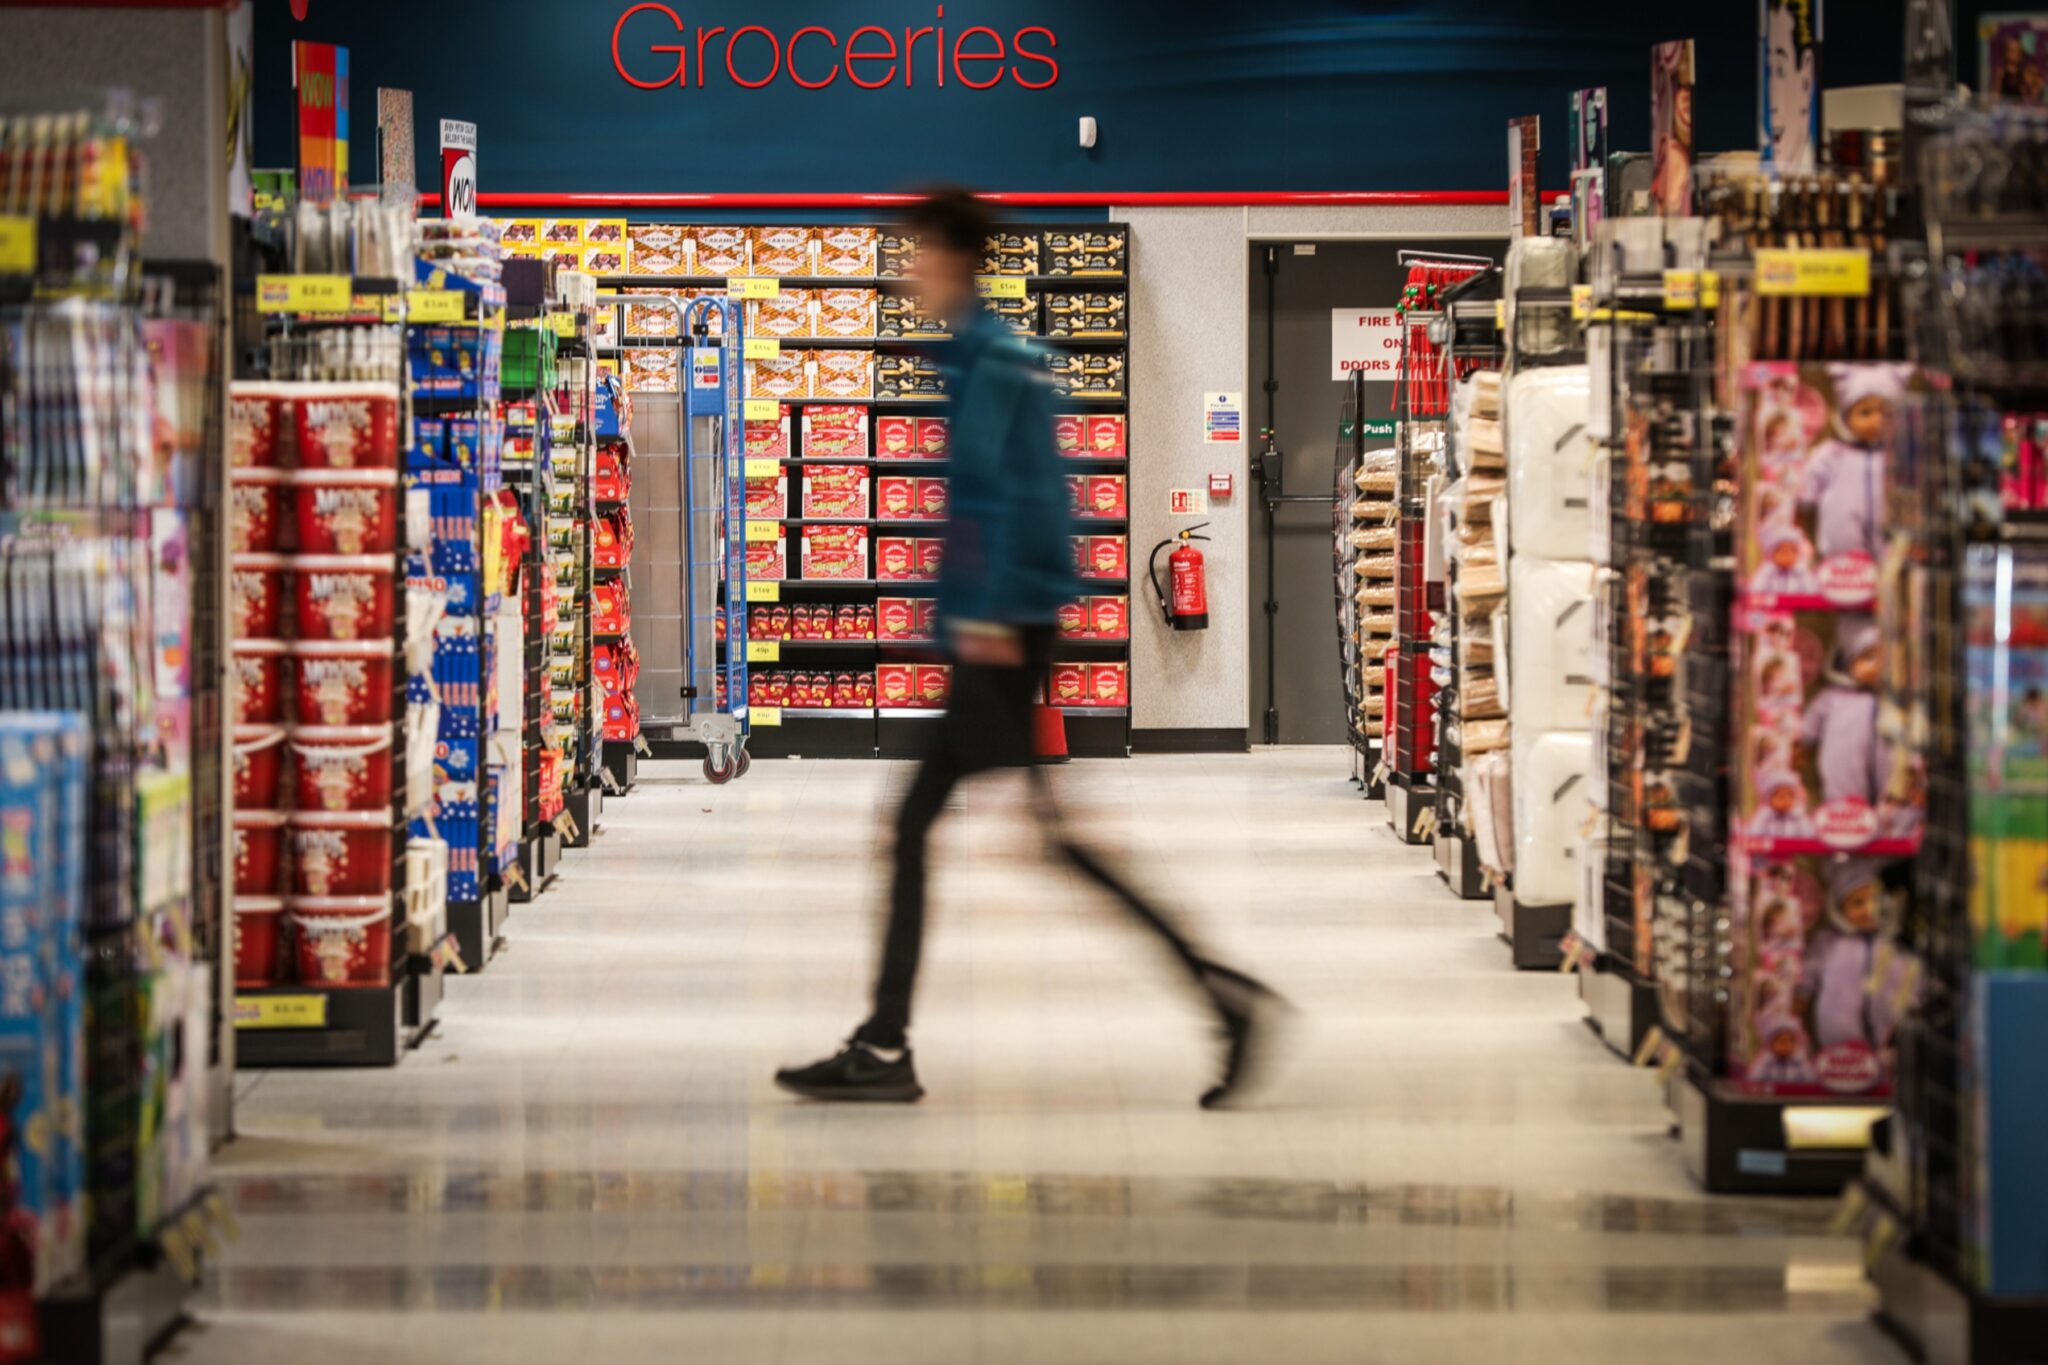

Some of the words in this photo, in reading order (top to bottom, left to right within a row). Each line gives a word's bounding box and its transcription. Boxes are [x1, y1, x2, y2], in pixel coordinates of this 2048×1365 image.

[611, 2, 1059, 89] Groceries
[1359, 316, 1391, 327] FIRE
[1341, 361, 1390, 371] DOORS
[1363, 424, 1393, 434] Push
